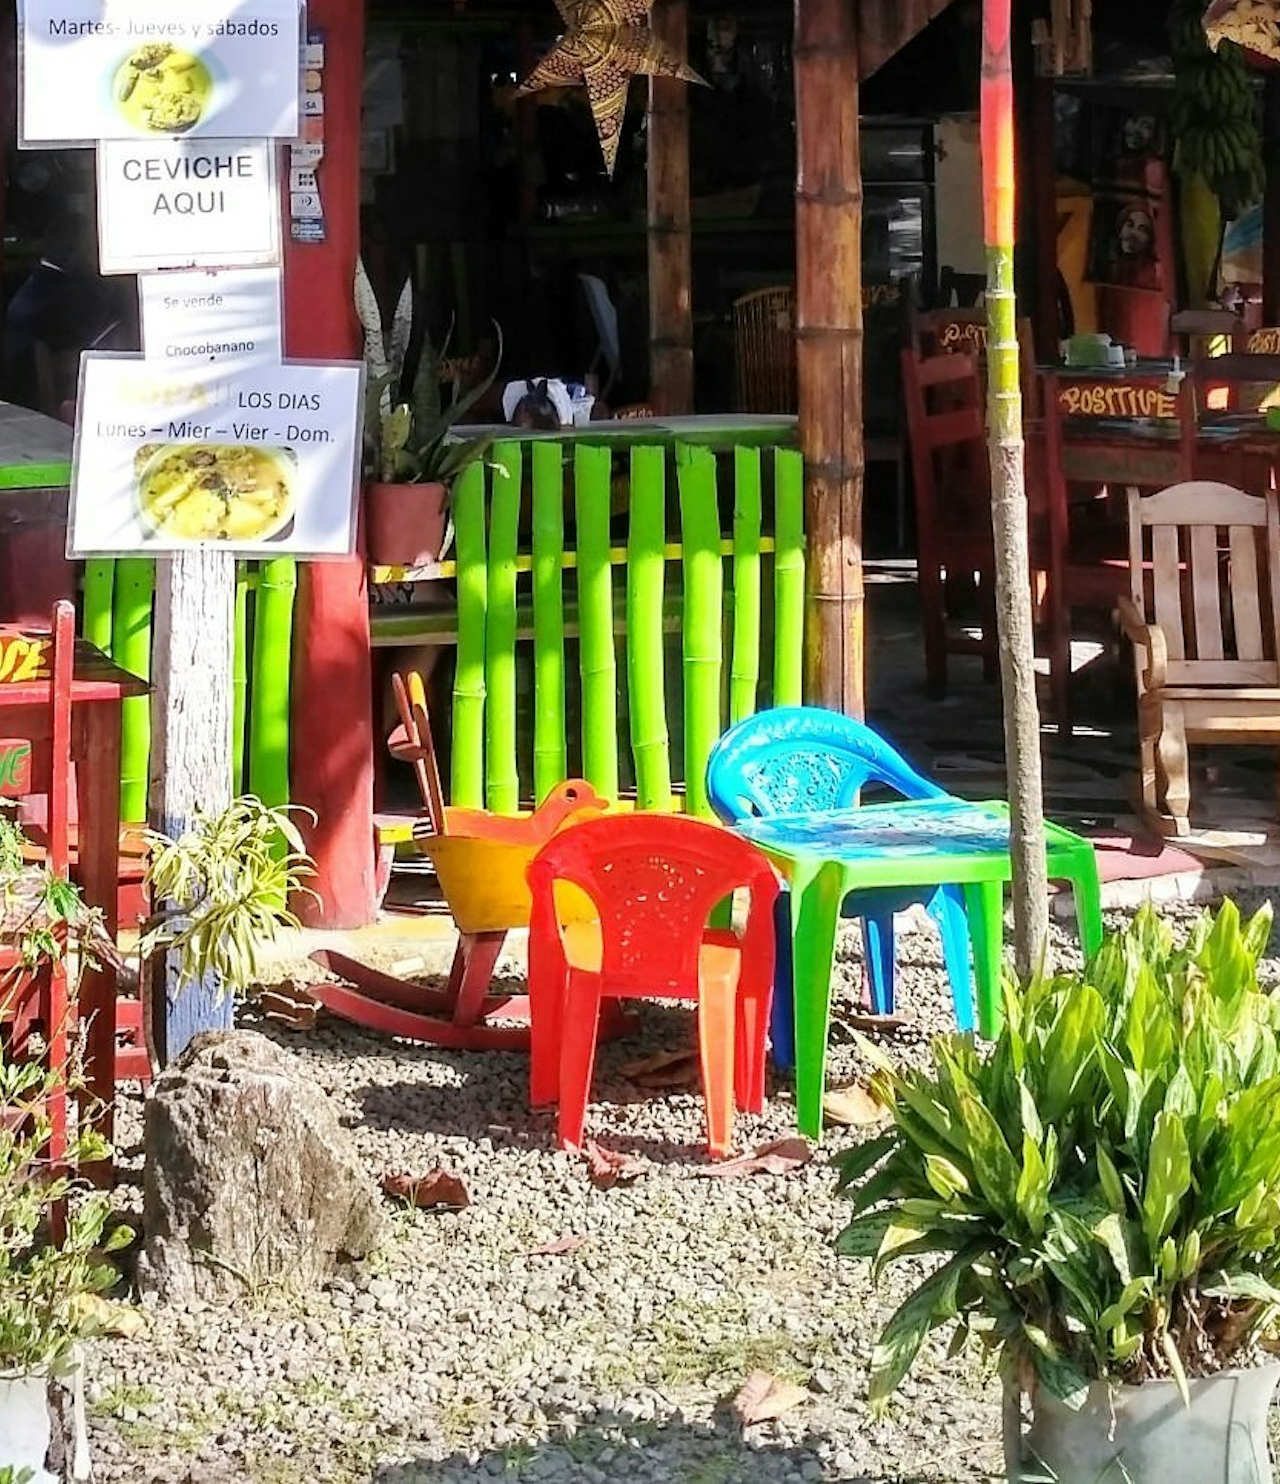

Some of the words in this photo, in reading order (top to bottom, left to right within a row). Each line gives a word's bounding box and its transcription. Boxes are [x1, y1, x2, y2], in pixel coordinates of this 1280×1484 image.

[127, 20, 186, 36] Jueves
[191, 23, 202, 39] y
[208, 19, 279, 37] sábados
[122, 156, 253, 181] CEVICHE
[153, 191, 225, 215] AQUI
[163, 296, 179, 309] Se
[182, 293, 223, 308] vende
[165, 341, 255, 358] Chocobanano
[238, 391, 272, 409] LOS
[278, 393, 321, 411] DIAS
[1059, 386, 1176, 417] POSITIVE
[96, 420, 146, 438] Lunes
[168, 420, 211, 439] Mier
[232, 421, 269, 440] Vier
[286, 425, 336, 443] Dom.
